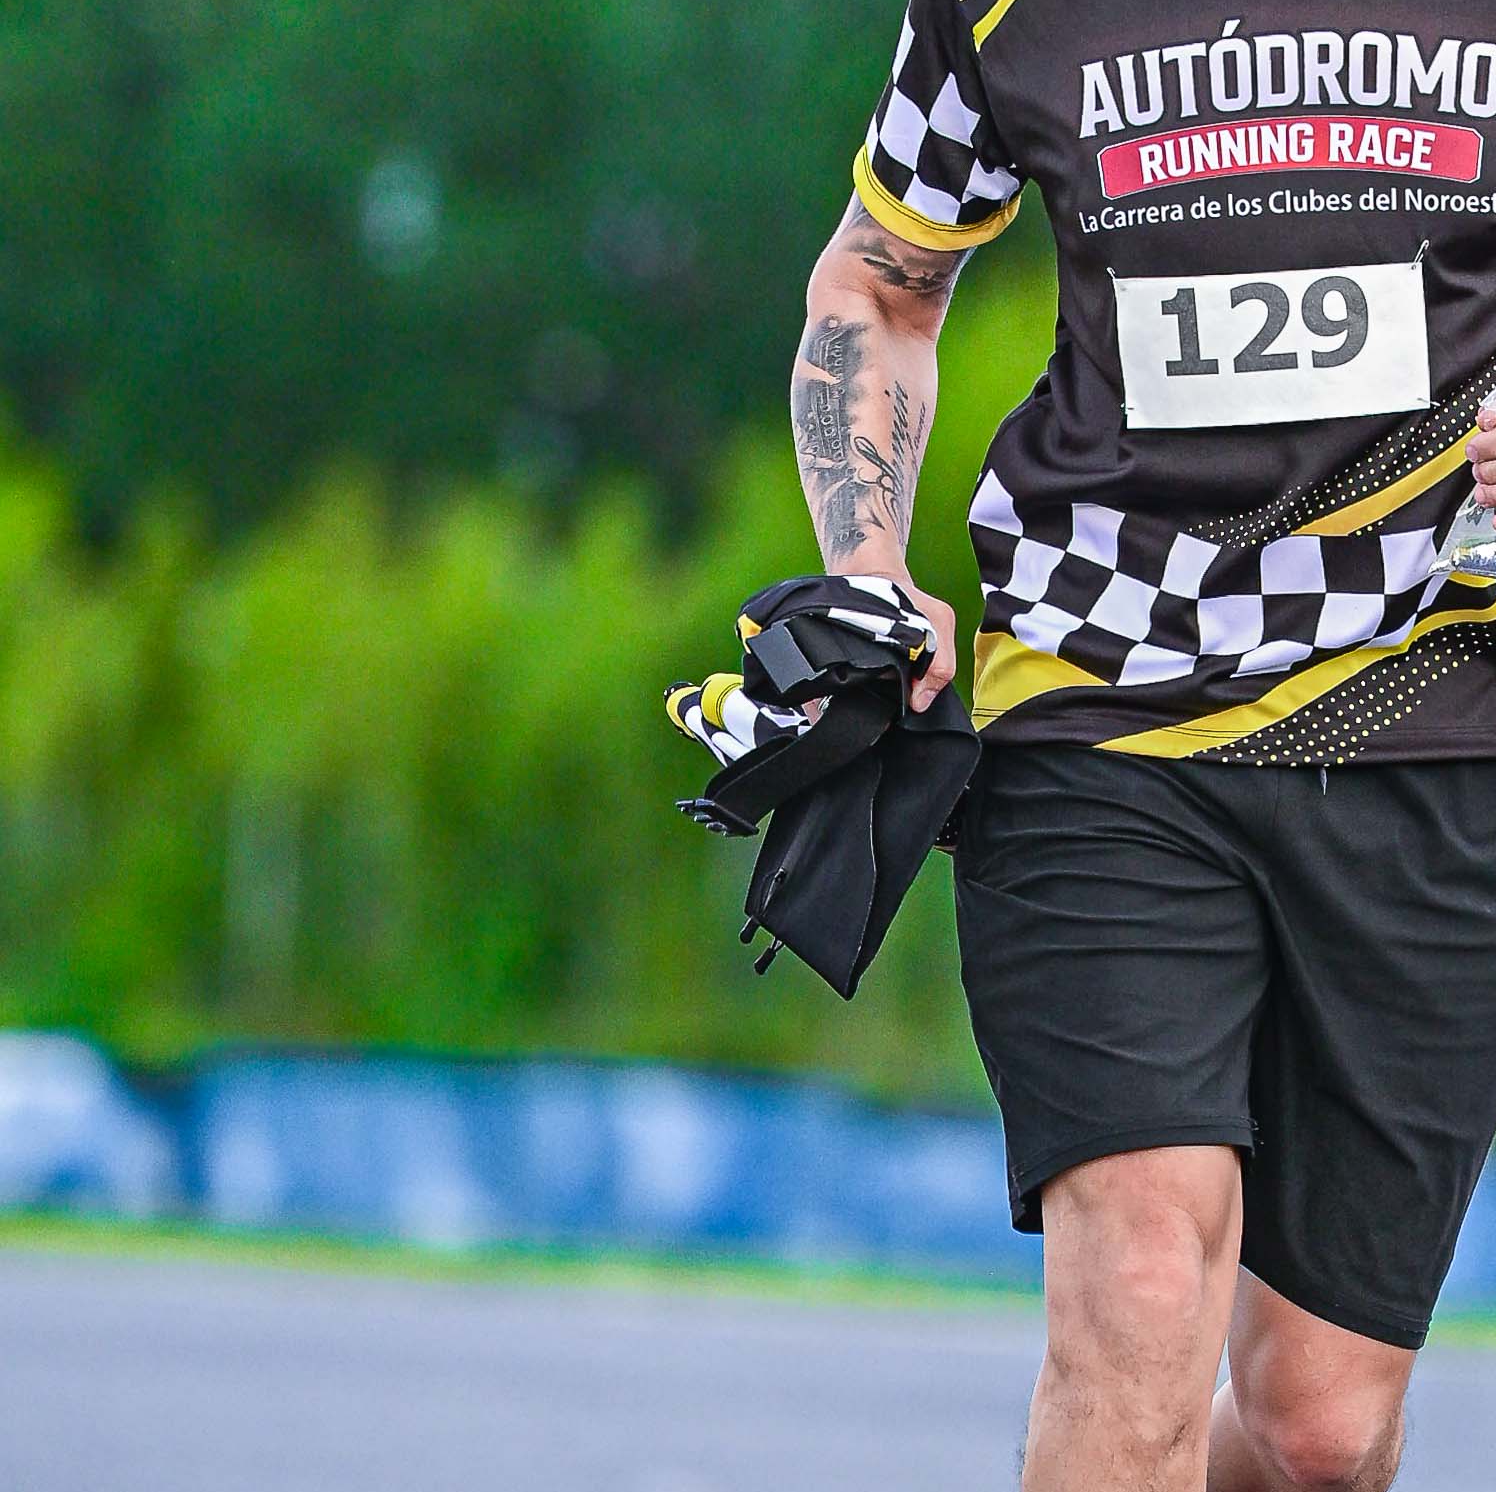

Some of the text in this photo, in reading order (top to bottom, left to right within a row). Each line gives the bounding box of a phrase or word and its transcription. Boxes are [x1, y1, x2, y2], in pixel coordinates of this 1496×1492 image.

[1138, 122, 1436, 186] RUNNING RACE
[1079, 211, 1100, 233] La
[1100, 204, 1184, 230] Carrera
[1189, 196, 1222, 220] de
[1228, 192, 1263, 217] los
[1268, 189, 1352, 214] Clubes
[1358, 187, 1398, 211] del
[1160, 276, 1369, 376] 129
